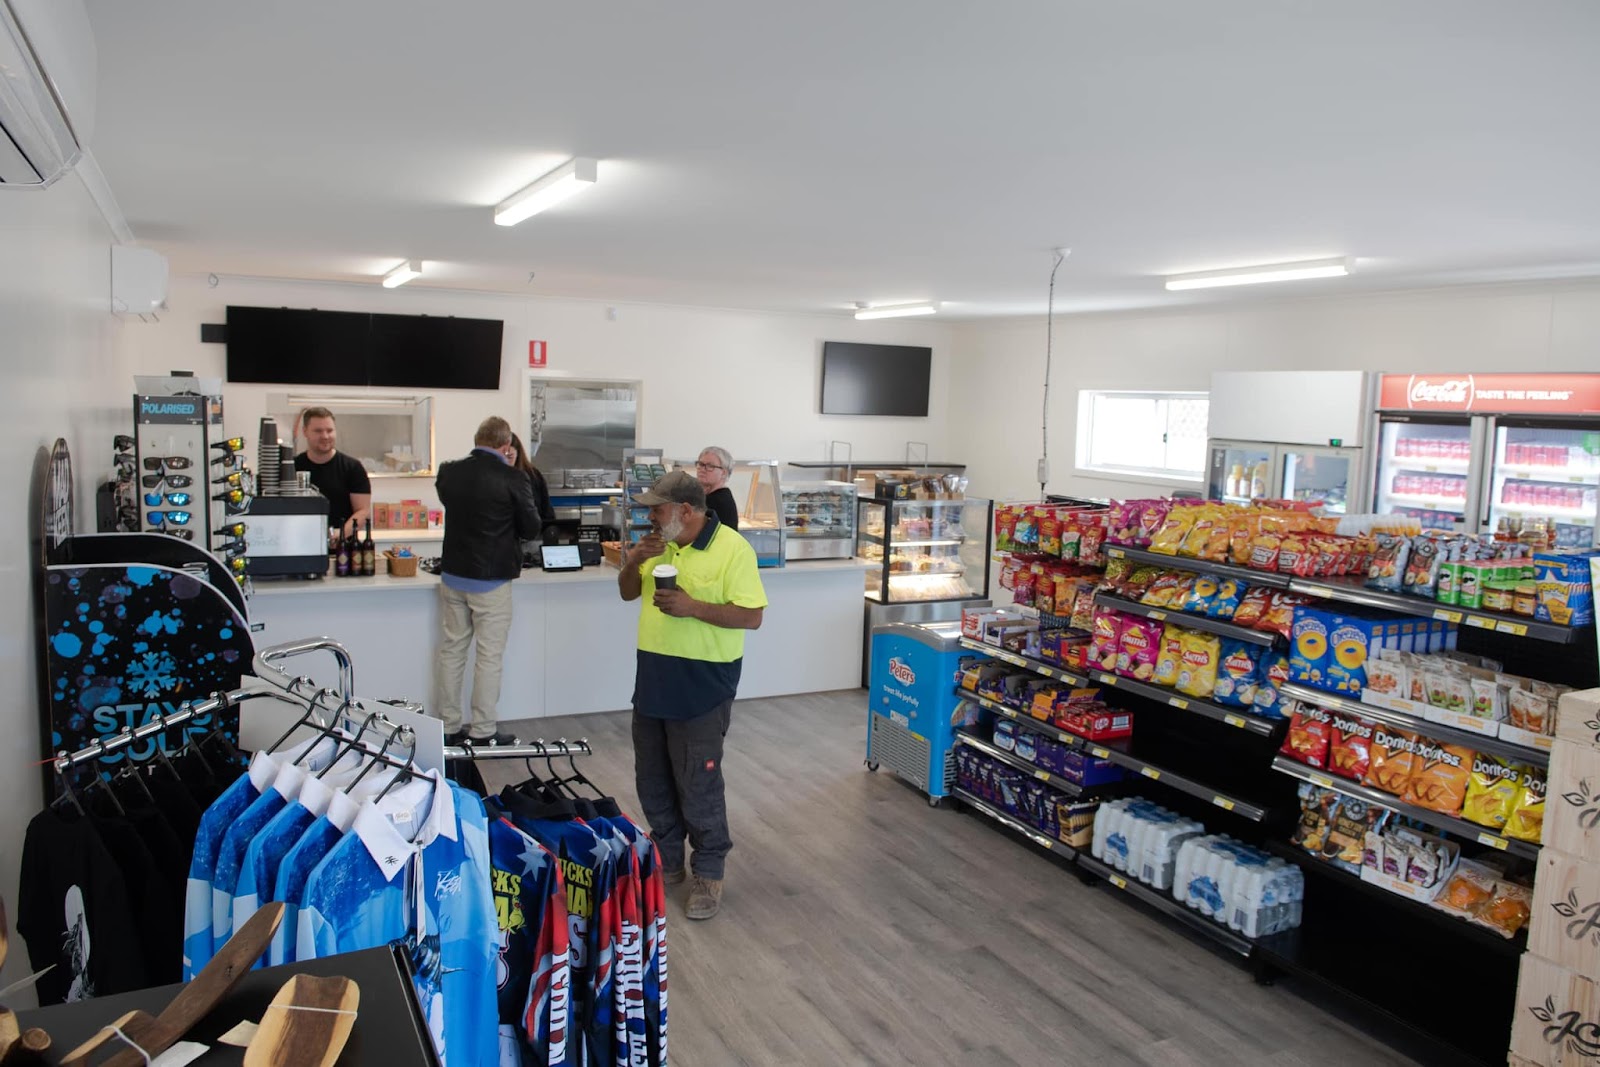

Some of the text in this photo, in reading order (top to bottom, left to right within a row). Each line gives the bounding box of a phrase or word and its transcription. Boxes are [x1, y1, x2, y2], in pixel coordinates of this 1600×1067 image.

[1475, 390, 1504, 400] TASTE
[1505, 390, 1525, 400] THE
[142, 403, 194, 414] POLARISED
[889, 659, 915, 684] Peters
[1472, 759, 1518, 782] Doritos
